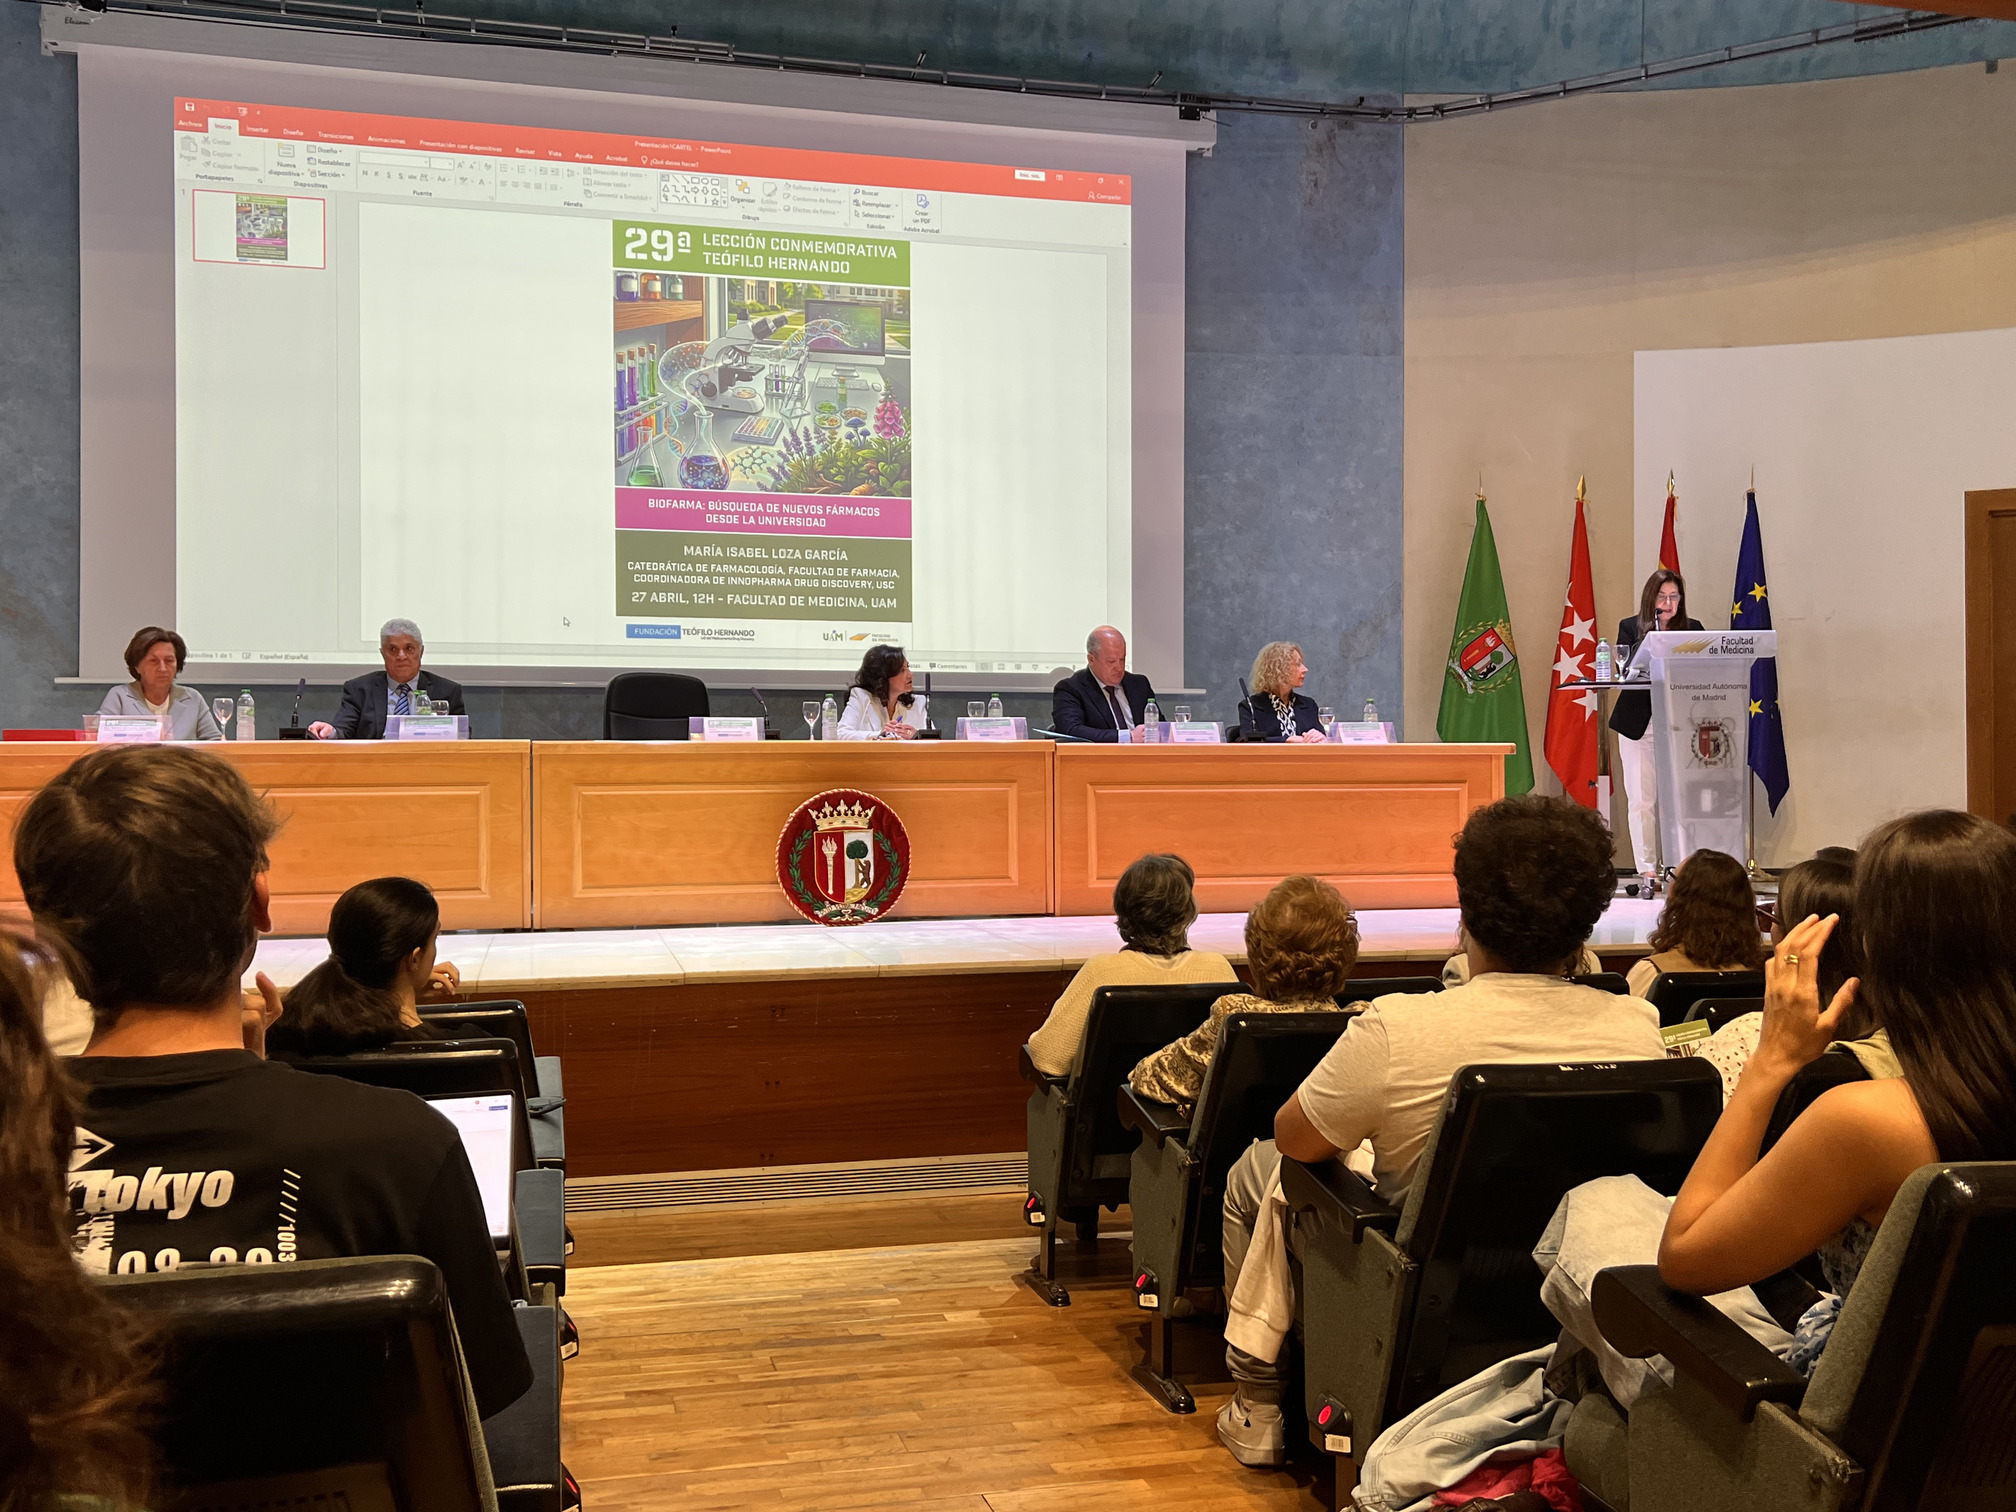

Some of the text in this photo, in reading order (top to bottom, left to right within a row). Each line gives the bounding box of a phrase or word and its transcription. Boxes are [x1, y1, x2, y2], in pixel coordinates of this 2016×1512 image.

[703, 232, 897, 258] LECCIÓN CONMEMORATIVA
[703, 250, 850, 274] TEÓFILO HERNANDO
[648, 498, 880, 517] BIOFARMA: BÚSQUEDA DE NUEVOS FÁRMACOS
[706, 514, 826, 527] DESDE LA UNIVERSIDAD
[684, 544, 848, 561] MARÍA ISABEL LOZA GARCÍA
[627, 560, 900, 579] CATEDRÁTICA DE FARMACOLOGÍA, FACULTAD DE FARMACIA,
[634, 574, 895, 590] COORDINADORA DE INNOPHARMA DRUG DISCOVERY, USC
[631, 591, 647, 602] 27
[650, 592, 689, 604] ABRIL,
[692, 593, 714, 604] 12H
[727, 594, 786, 606] FACULTAD
[790, 596, 805, 606] DE
[808, 596, 868, 608] MEDICINA,
[871, 598, 897, 608] UAM
[634, 626, 755, 637] FUNDACIÓN TEÓFILO HERNANDO
[823, 631, 843, 641] UAM
[1722, 636, 1754, 645] Facultad
[1721, 646, 1754, 654] Medicina
[65, 1166, 234, 1220] Tokyo
